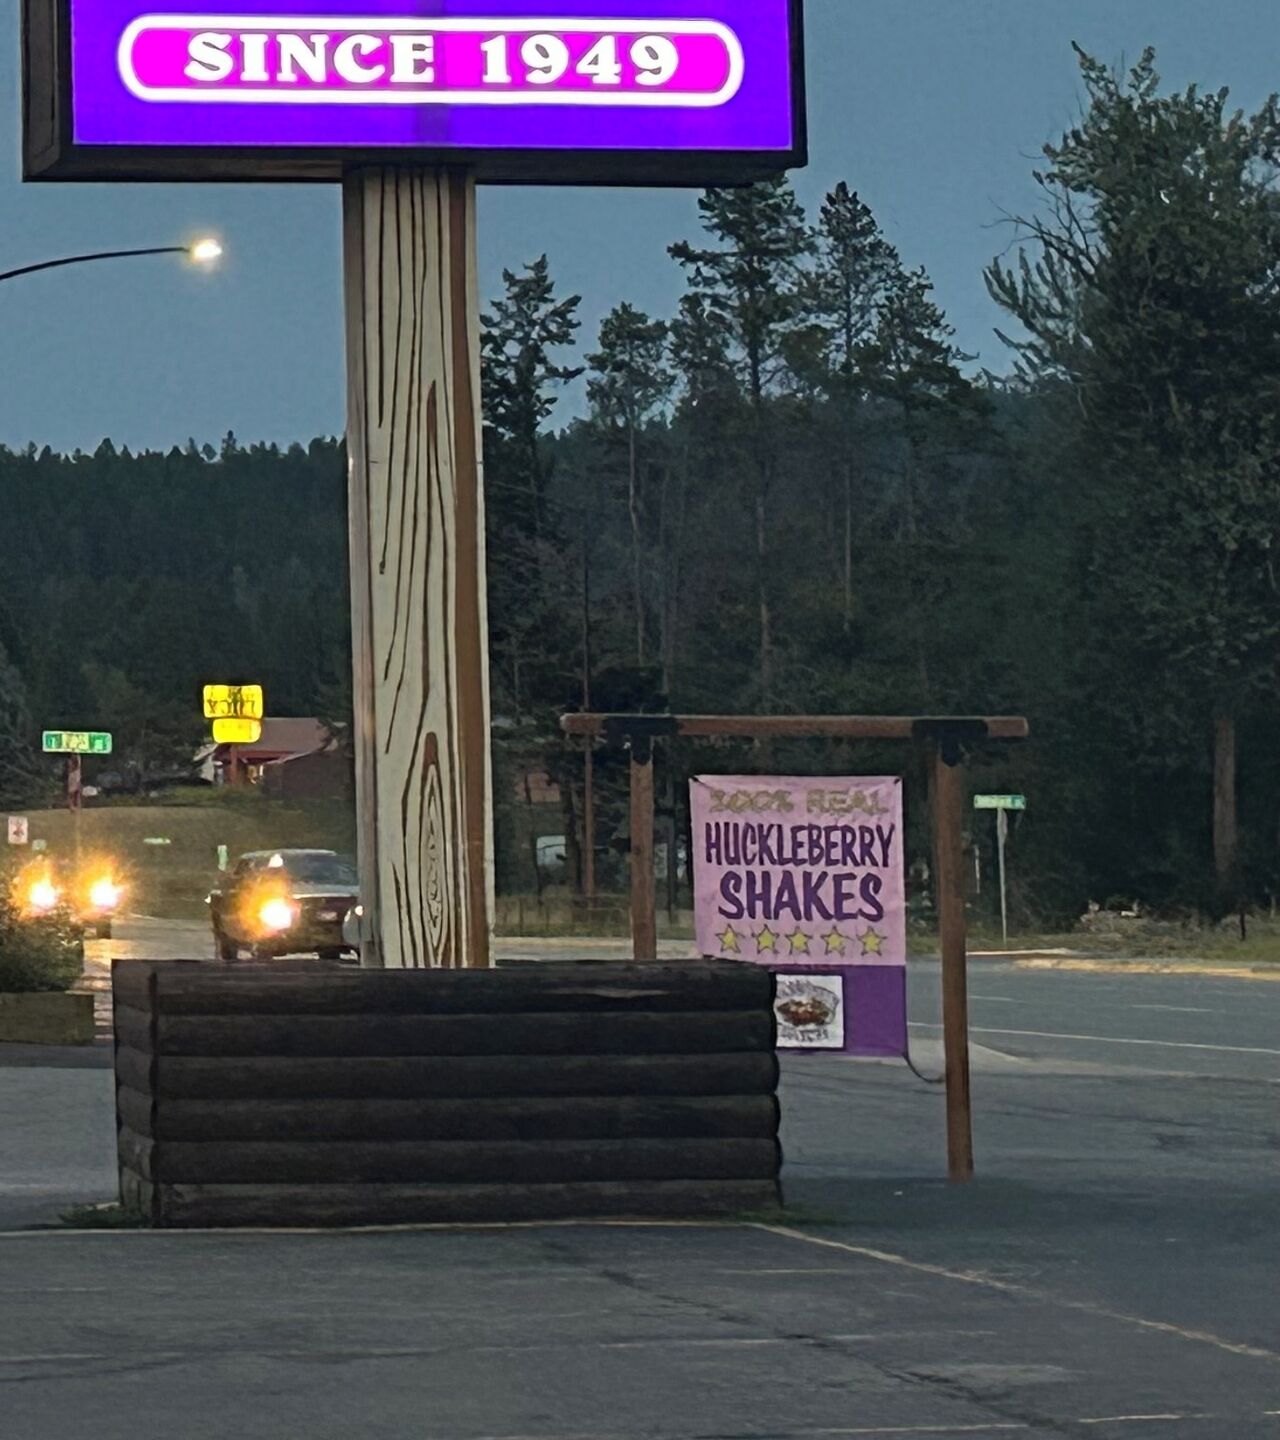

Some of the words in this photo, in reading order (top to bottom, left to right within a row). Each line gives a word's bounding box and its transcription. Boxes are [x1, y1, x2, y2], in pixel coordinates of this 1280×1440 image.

[183, 30, 436, 84] SINCE
[479, 33, 680, 87] 1949
[705, 821, 896, 868] HUCKLEBERRY
[718, 869, 885, 923] SHAKES
